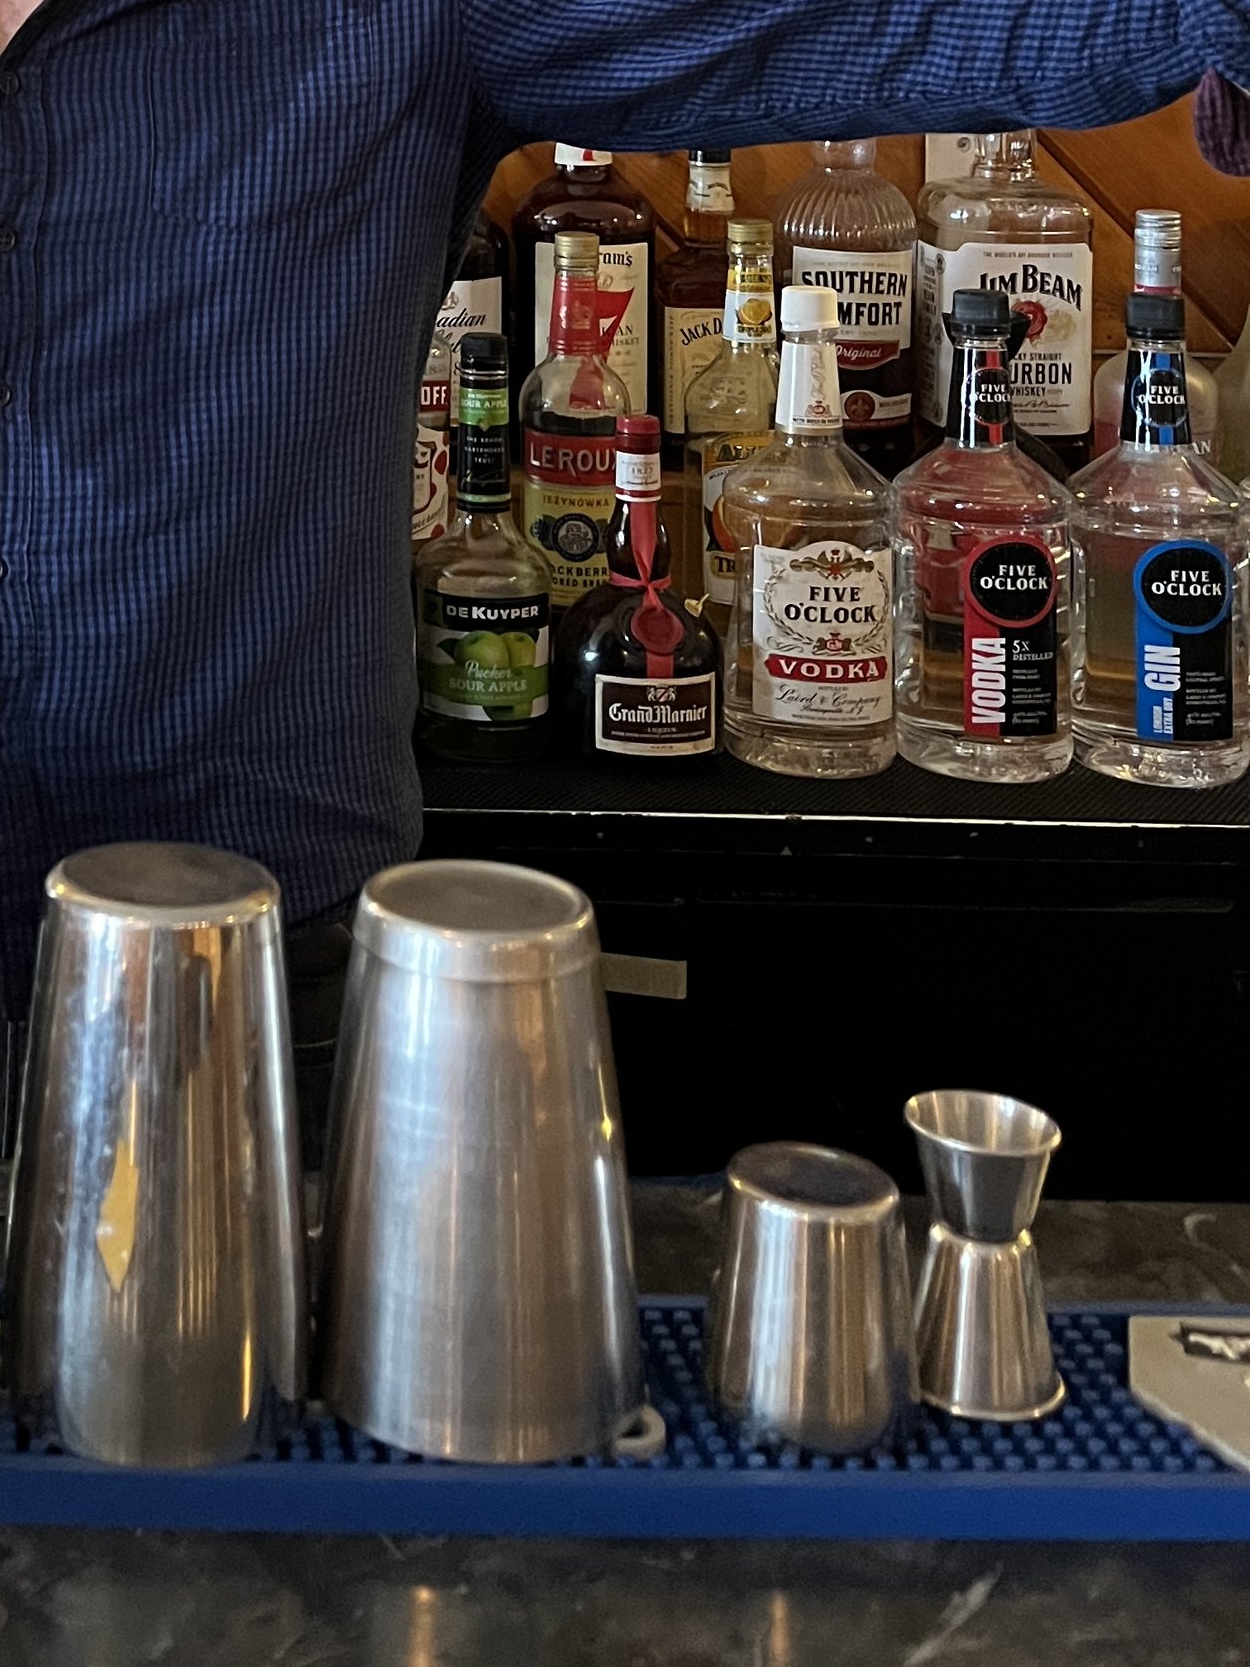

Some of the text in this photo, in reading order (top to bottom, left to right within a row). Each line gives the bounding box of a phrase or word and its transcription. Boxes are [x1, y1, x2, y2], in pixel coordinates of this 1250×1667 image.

[801, 270, 908, 297] SOUTHERN
[979, 263, 1083, 312] JIM BEAM
[436, 306, 487, 328] adian
[836, 301, 903, 327] MFORT
[680, 320, 712, 346] JACK
[835, 344, 883, 361] Original
[1029, 352, 1063, 362] STRAIGHT
[1011, 362, 1073, 386] URBON
[1138, 394, 1186, 405] O'CLOCK
[1151, 385, 1180, 395] FIVE
[529, 441, 617, 478] LEROU
[631, 466, 655, 476] 1827
[550, 563, 609, 577] ACKBERR
[998, 564, 1037, 577] FIVE
[1170, 569, 1211, 583] FIVE
[979, 575, 1050, 591] O'CLOCK
[1151, 580, 1223, 597] O'CLOCK
[809, 585, 861, 603] FIVE
[784, 602, 878, 624] O'CLOCK
[1012, 651, 1054, 662] DISTILLED
[465, 660, 513, 680] Pucker
[778, 658, 880, 679] VODKA
[1143, 644, 1182, 692] GIN
[449, 678, 528, 692] SOUR APPLE
[971, 637, 1006, 724] VODKA
[775, 683, 818, 704] Laird
[829, 691, 882, 709] Company
[609, 702, 708, 724] Grand Marnier
